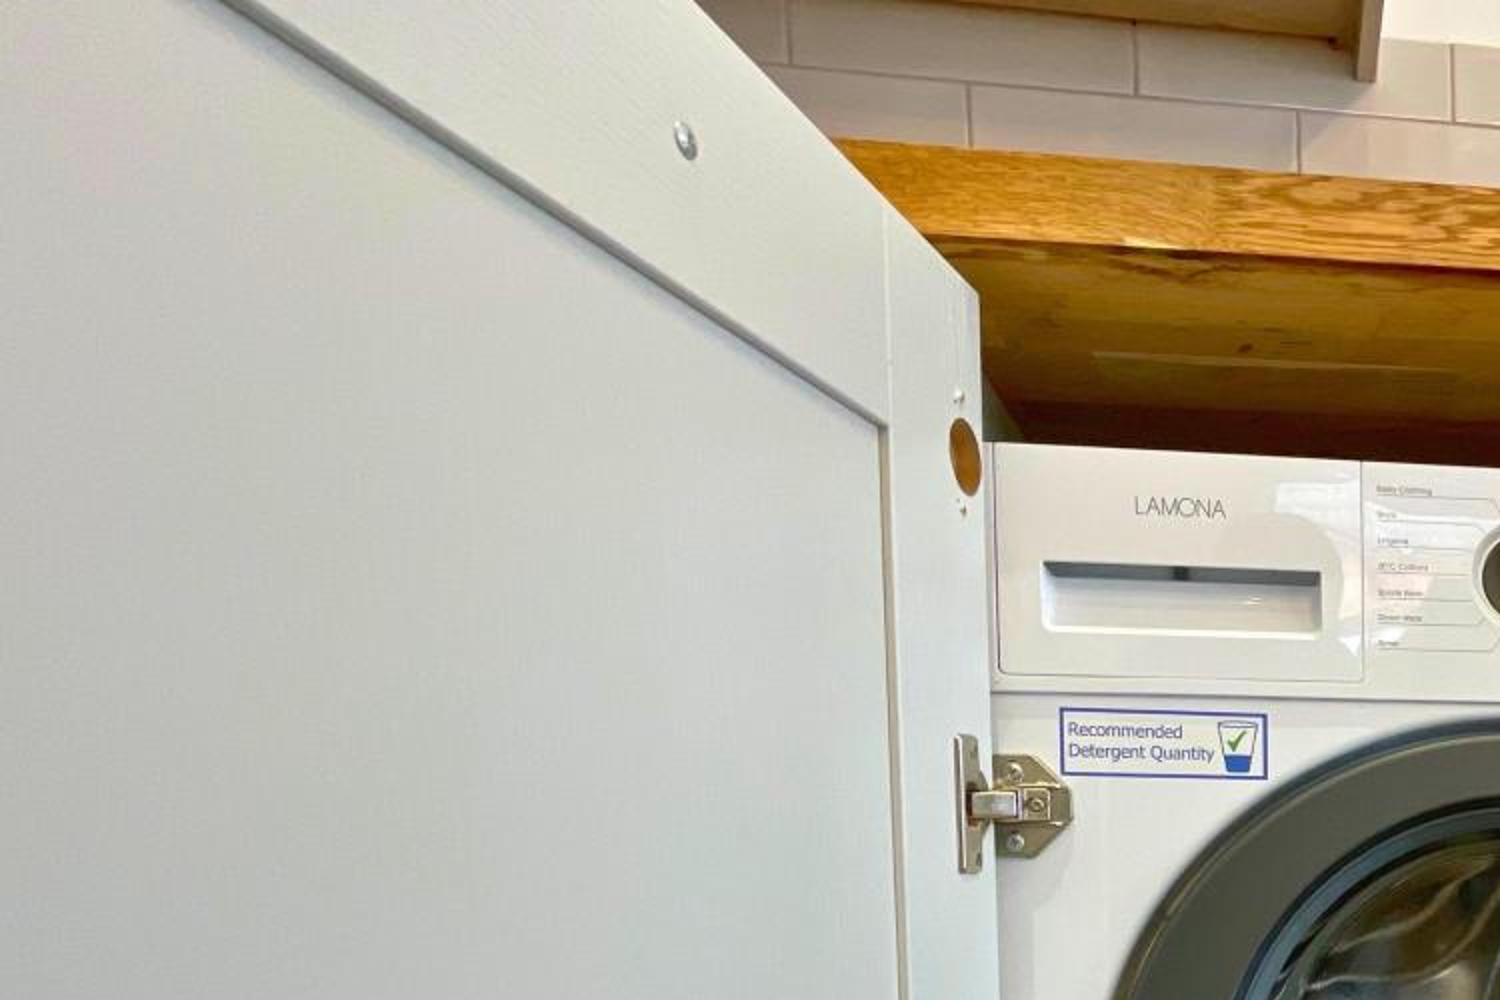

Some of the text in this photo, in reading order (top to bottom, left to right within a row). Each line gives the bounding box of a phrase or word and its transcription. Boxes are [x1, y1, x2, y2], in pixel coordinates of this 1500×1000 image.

[1135, 496, 1227, 519] LAMONA
[1068, 721, 1183, 740] Recommended
[1068, 744, 1216, 764] Detergent Quantity
